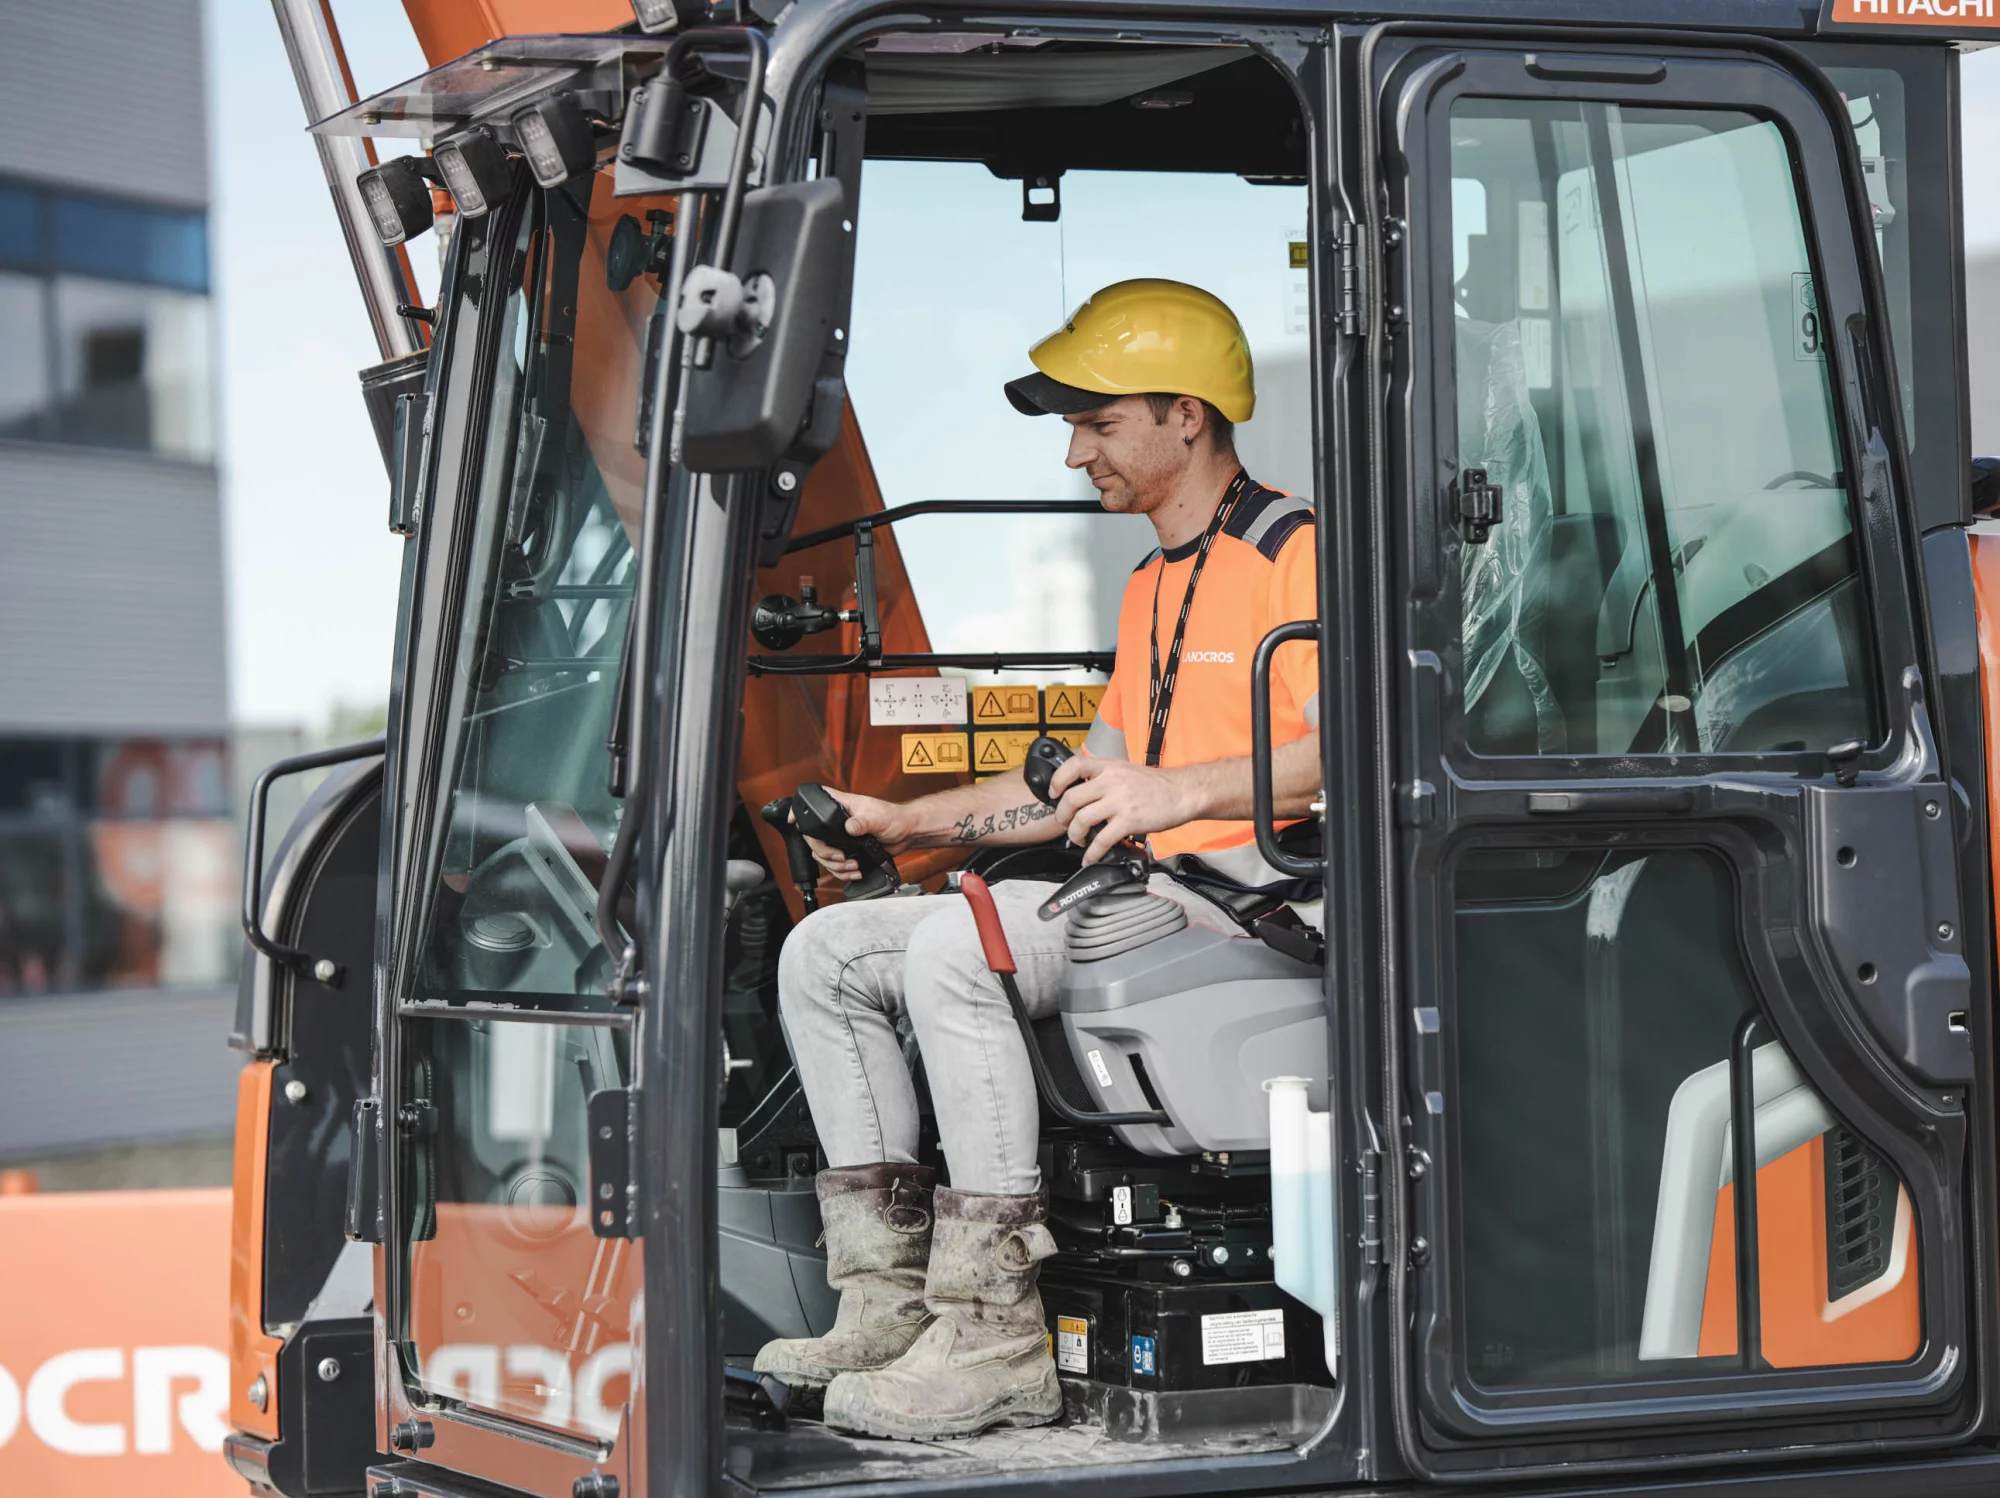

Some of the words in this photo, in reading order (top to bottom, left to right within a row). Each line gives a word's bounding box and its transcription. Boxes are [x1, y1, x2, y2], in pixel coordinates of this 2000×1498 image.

[1802, 312, 1825, 354] 9
[1182, 651, 1235, 663] LANDCROS
[998, 807, 1020, 831] A
[0, 1346, 231, 1456] CR
